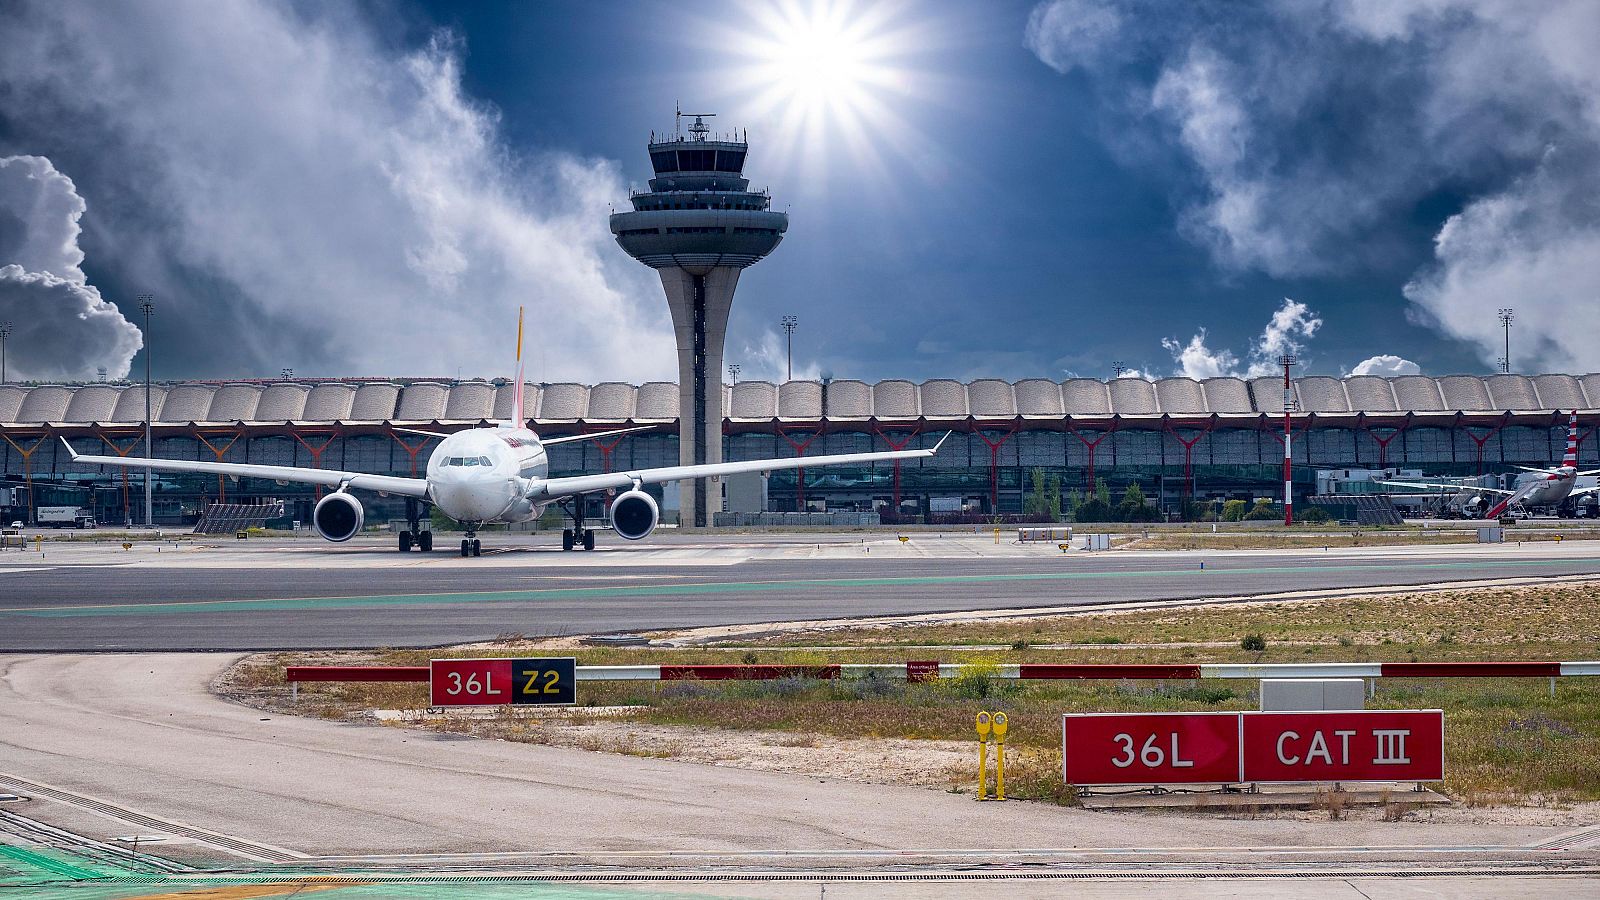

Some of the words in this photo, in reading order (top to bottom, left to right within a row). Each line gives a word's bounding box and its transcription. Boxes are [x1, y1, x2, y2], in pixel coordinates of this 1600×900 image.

[446, 671, 501, 695] 36L
[522, 670, 560, 694] Z2
[1111, 732, 1194, 768] 36L
[1276, 730, 1356, 765] CAT
[1372, 729, 1411, 764] III
